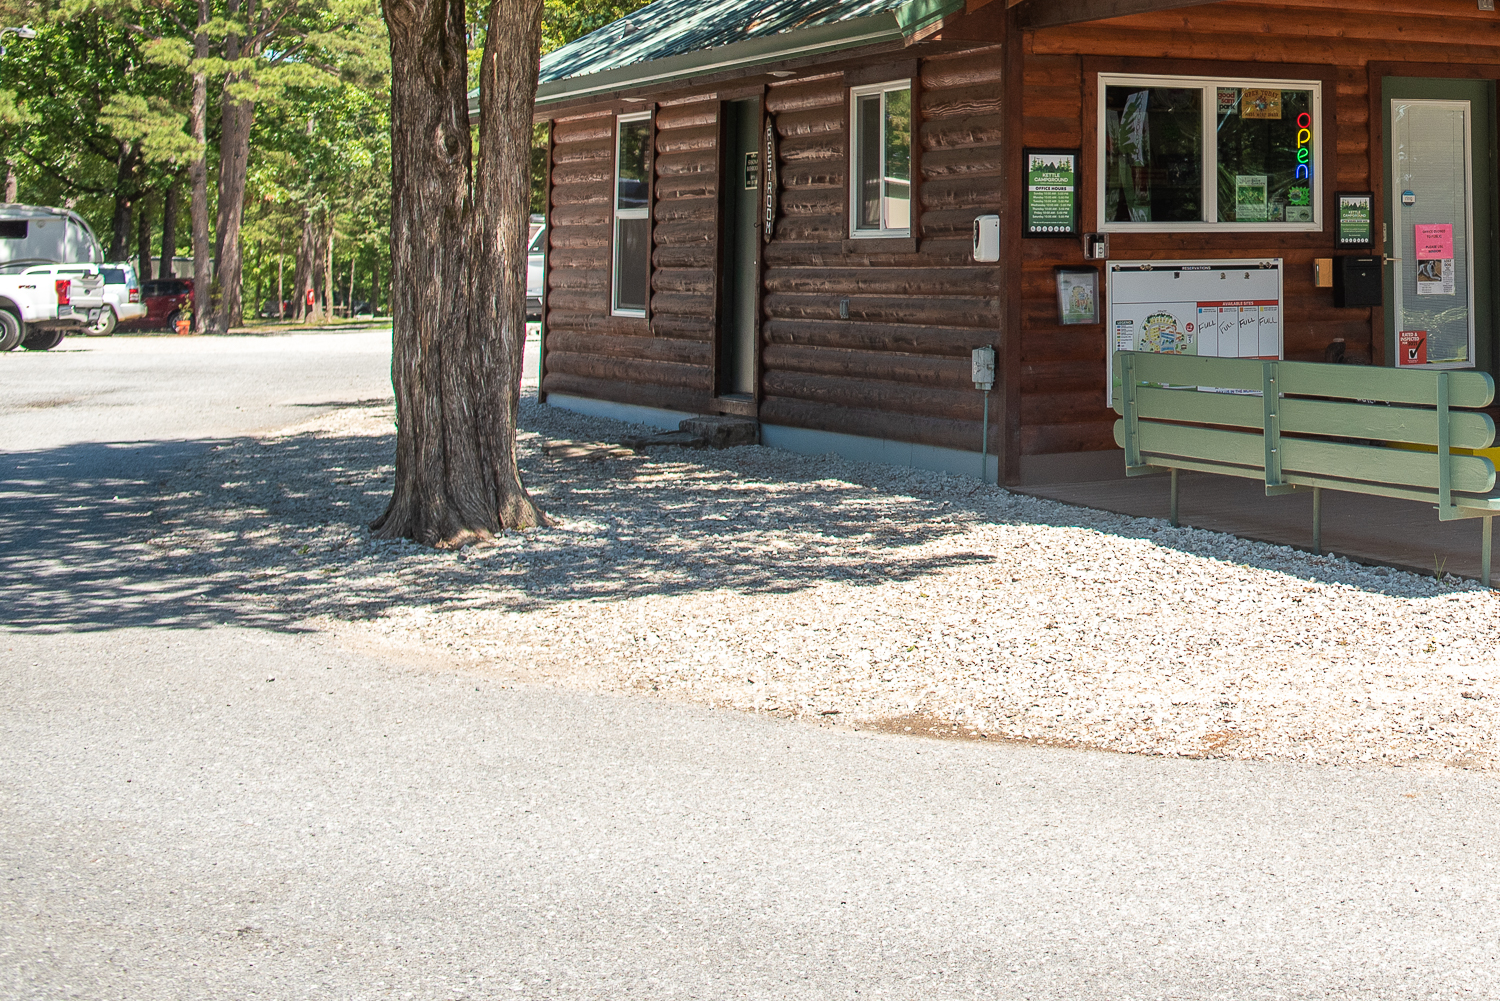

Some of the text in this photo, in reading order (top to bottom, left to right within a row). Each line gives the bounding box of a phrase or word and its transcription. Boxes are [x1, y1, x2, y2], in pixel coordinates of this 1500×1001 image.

[1218, 92, 1235, 100] good
[1198, 320, 1217, 334] FULL
[1219, 320, 1235, 334] FULL
[1239, 317, 1256, 329] FULL
[1258, 316, 1277, 326] FULL
